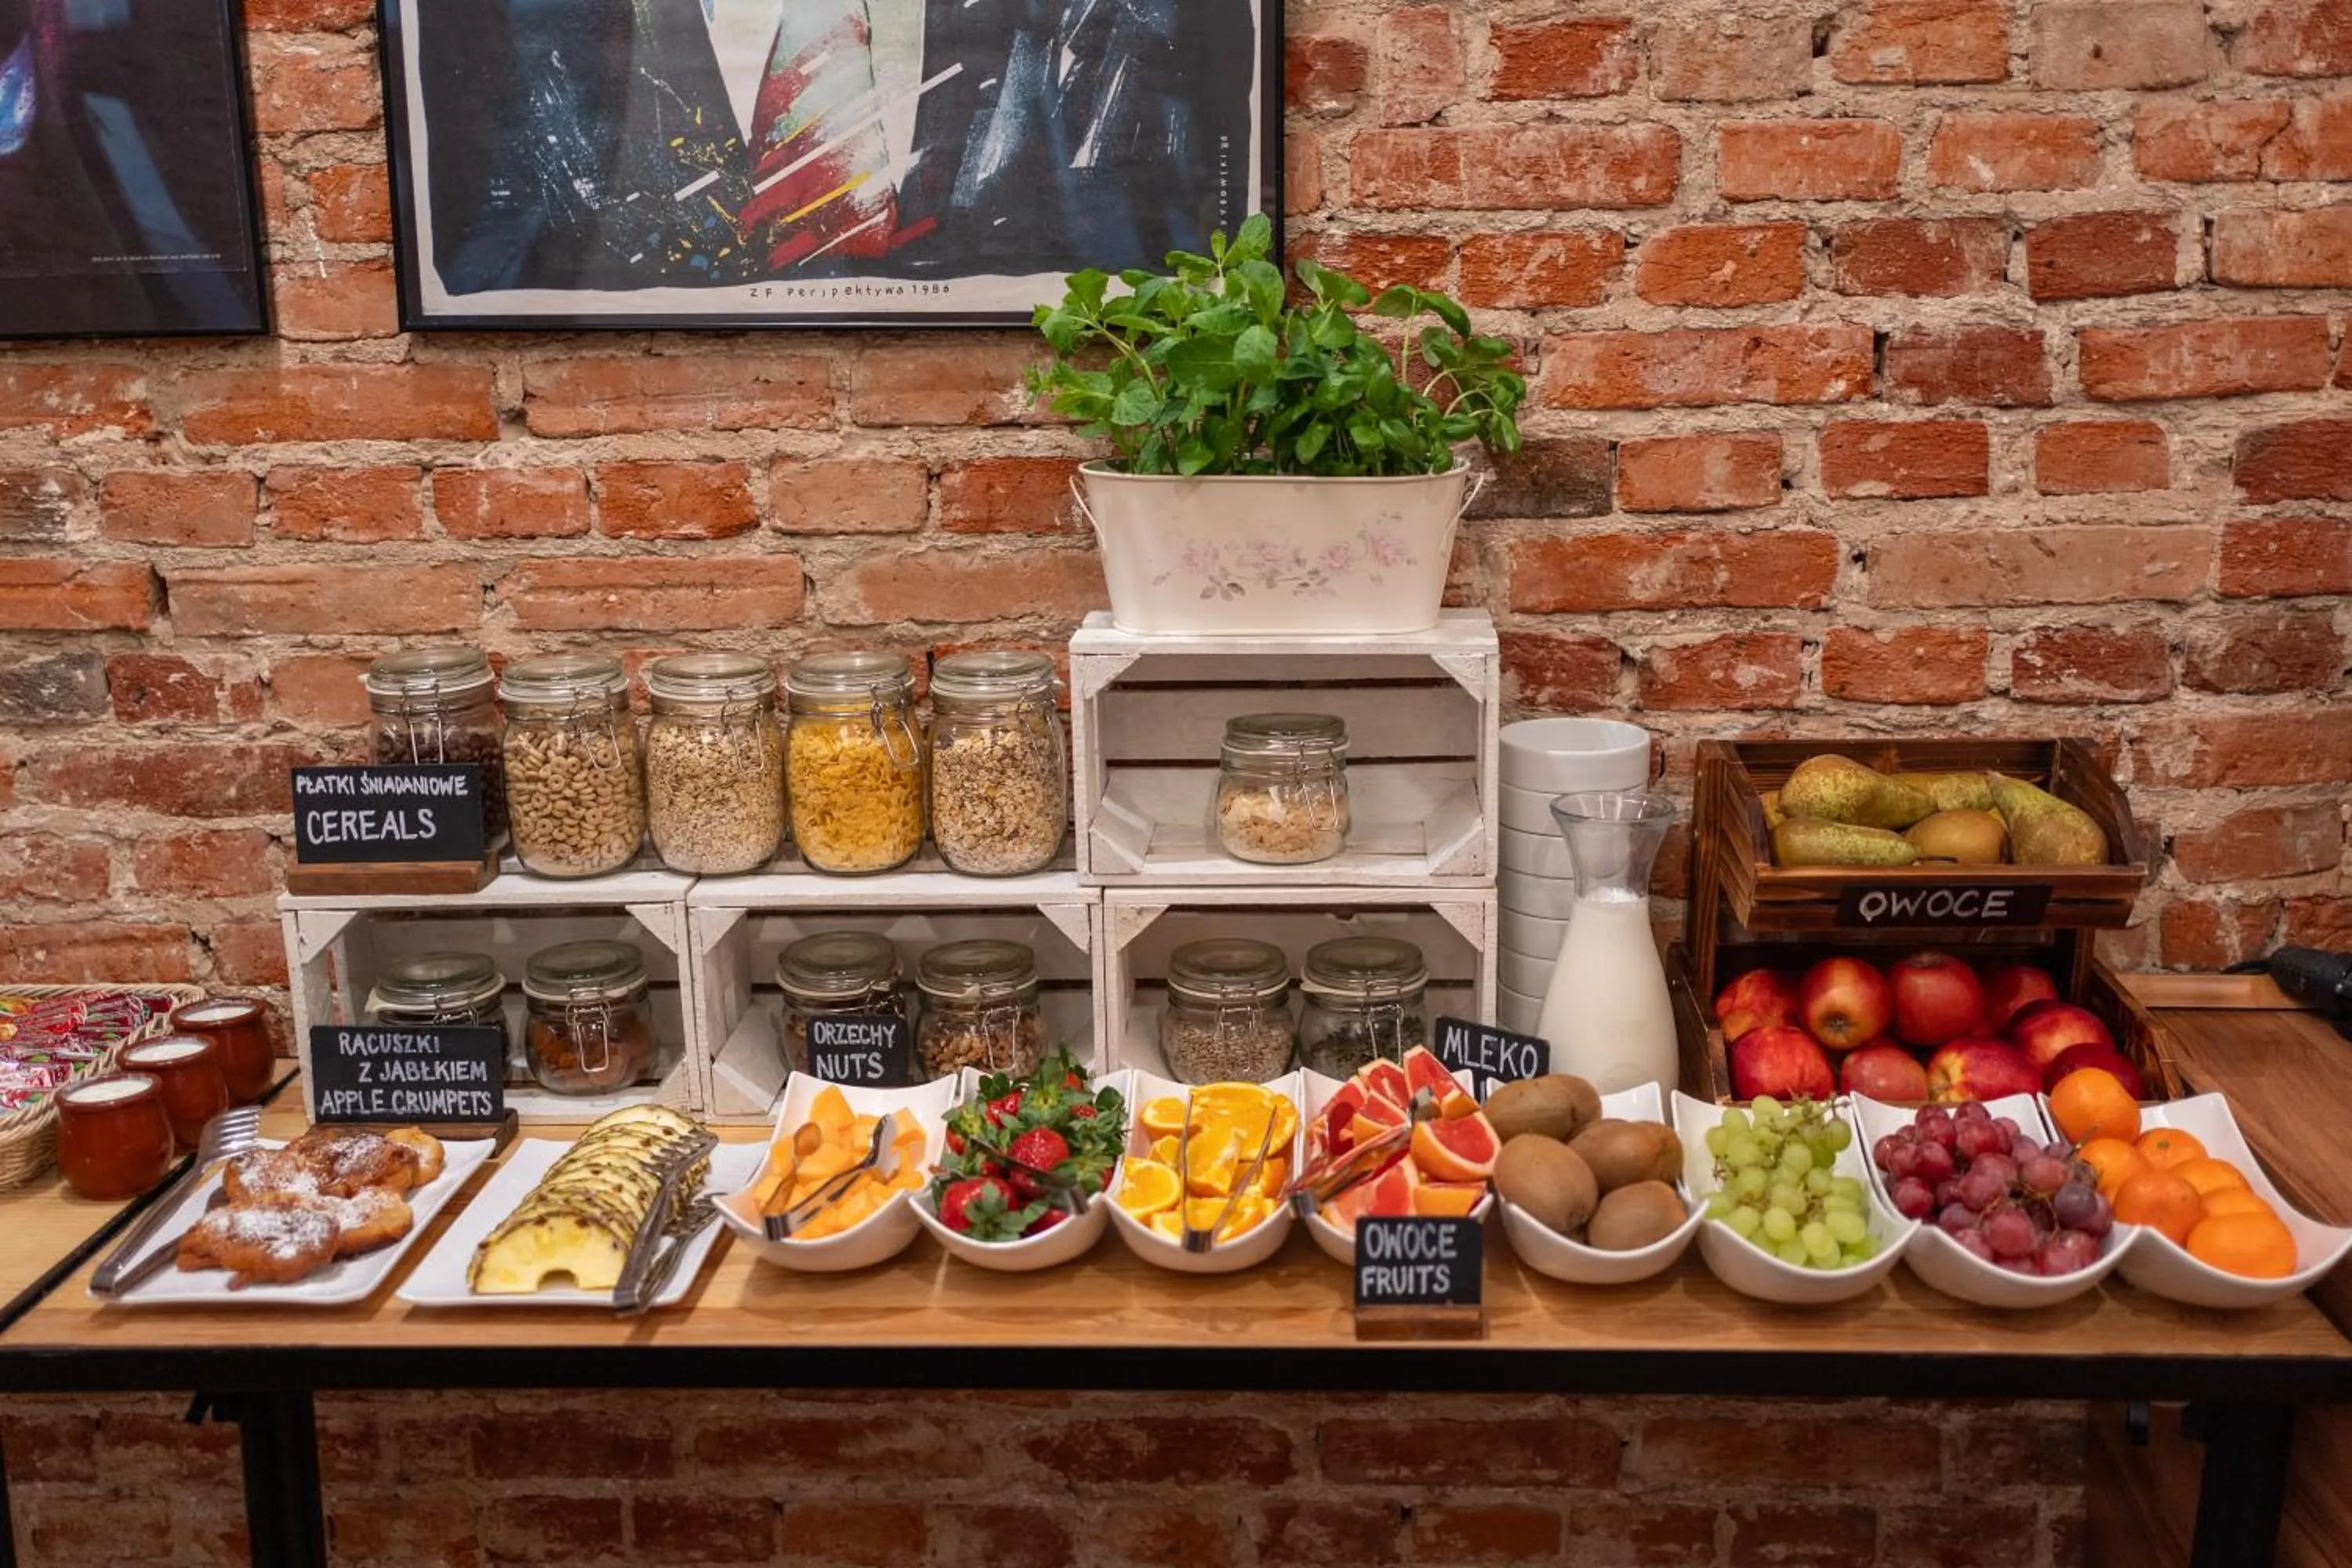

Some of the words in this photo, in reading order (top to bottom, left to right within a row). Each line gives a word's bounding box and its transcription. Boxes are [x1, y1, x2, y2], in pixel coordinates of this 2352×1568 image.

[912, 283, 950, 296] 1986
[296, 774, 356, 796] PŁATKI
[361, 771, 469, 796] ŚNIADANIOWE
[307, 808, 437, 845] CEREALS
[1859, 890, 2015, 922] OWOCE
[338, 1032, 441, 1056] RACUSZKI
[814, 1021, 896, 1048] ORZECHY
[816, 1051, 885, 1080] NUTS
[1443, 1025, 1538, 1080] MLEKO
[358, 1062, 373, 1083] Z
[379, 1060, 488, 1083] JABŁKIEM
[320, 1089, 389, 1115] APPLE
[392, 1089, 493, 1116] CRUMPETS
[1365, 1222, 1458, 1260] OWOCE
[1361, 1263, 1450, 1297] FRUITS
